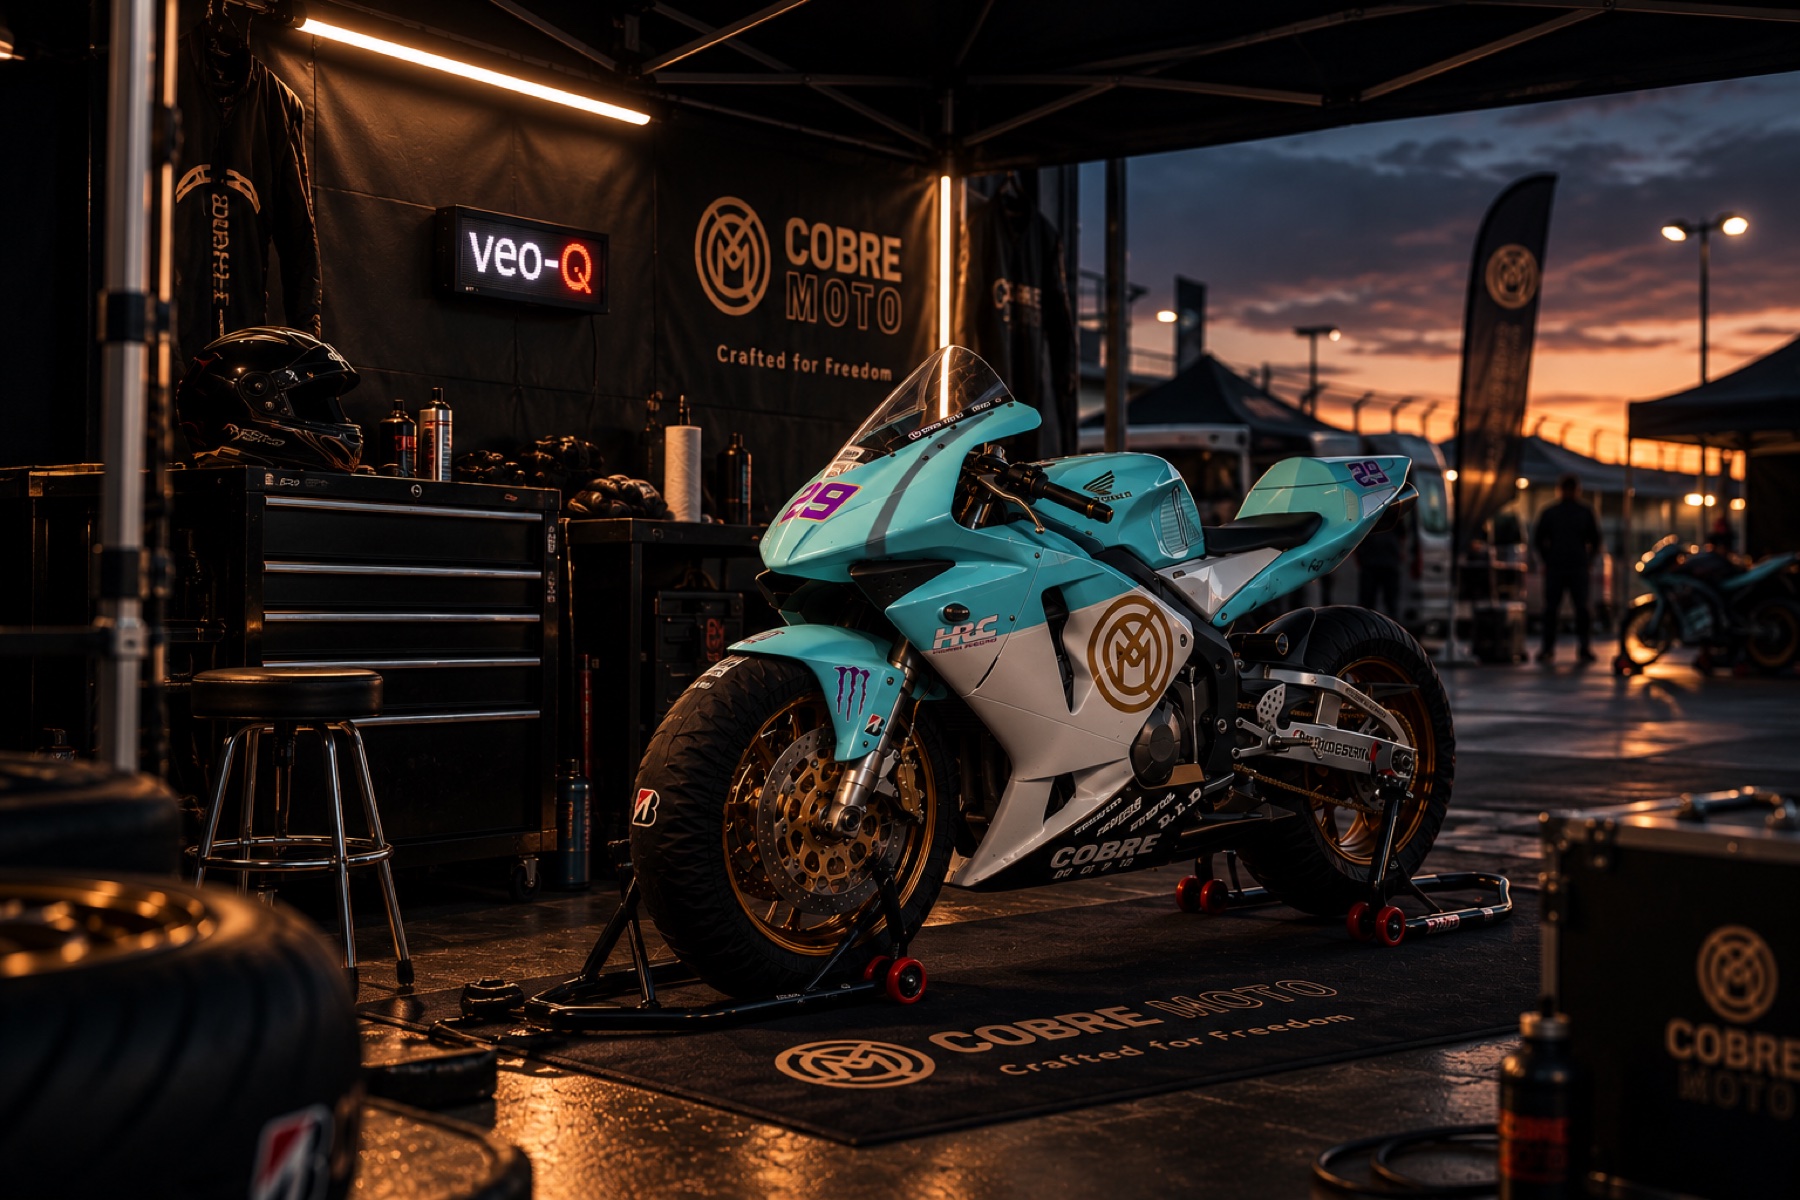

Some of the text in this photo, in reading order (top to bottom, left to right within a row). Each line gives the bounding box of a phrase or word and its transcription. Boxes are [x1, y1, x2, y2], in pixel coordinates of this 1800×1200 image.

[468, 231, 592, 294] veo-Q
[785, 217, 902, 282] COBRE
[786, 270, 902, 335] MOTO
[716, 344, 892, 381] Crafted for Freedom
[777, 481, 863, 526] 29
[1345, 460, 1391, 487] 29
[932, 614, 998, 649] HRC
[1050, 832, 1162, 868] COBRE
[928, 979, 1338, 1053] COBRE MOTO
[1000, 1014, 1355, 1076] Crafted for Freedom
[1665, 1018, 1800, 1081] COBRE
